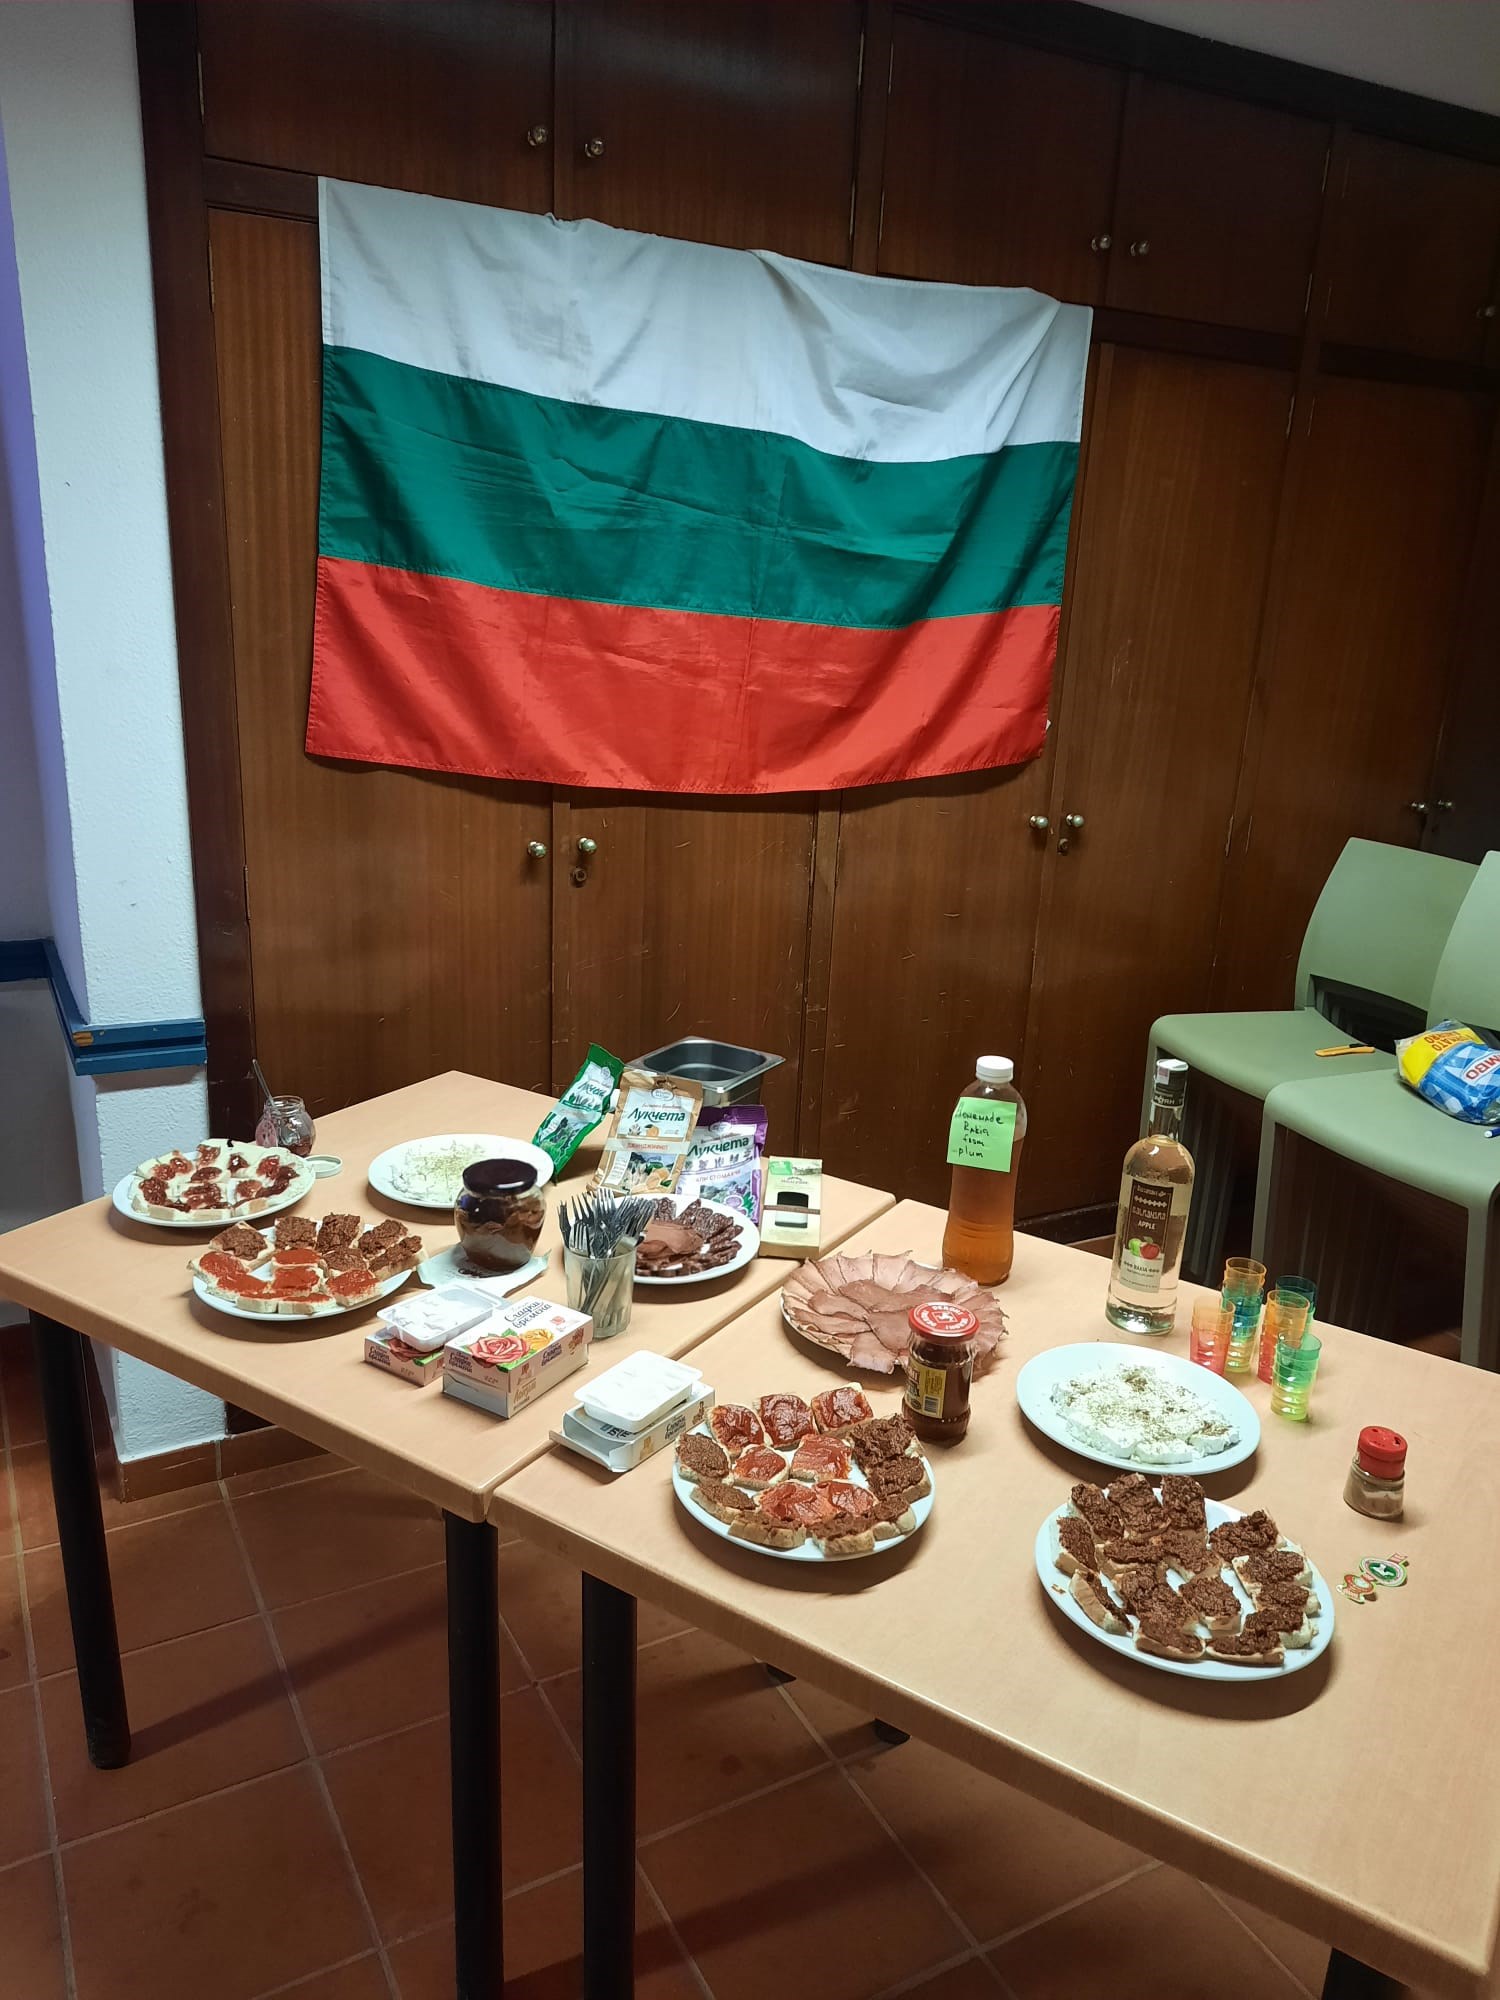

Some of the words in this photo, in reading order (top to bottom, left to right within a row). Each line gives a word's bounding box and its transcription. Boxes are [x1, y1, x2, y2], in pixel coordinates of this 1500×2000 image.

[627, 1107, 686, 1123] Лукчета
[687, 1137, 750, 1159] Лукчета
[958, 1146, 983, 1158] plum
[1138, 1219, 1156, 1231] APPLE
